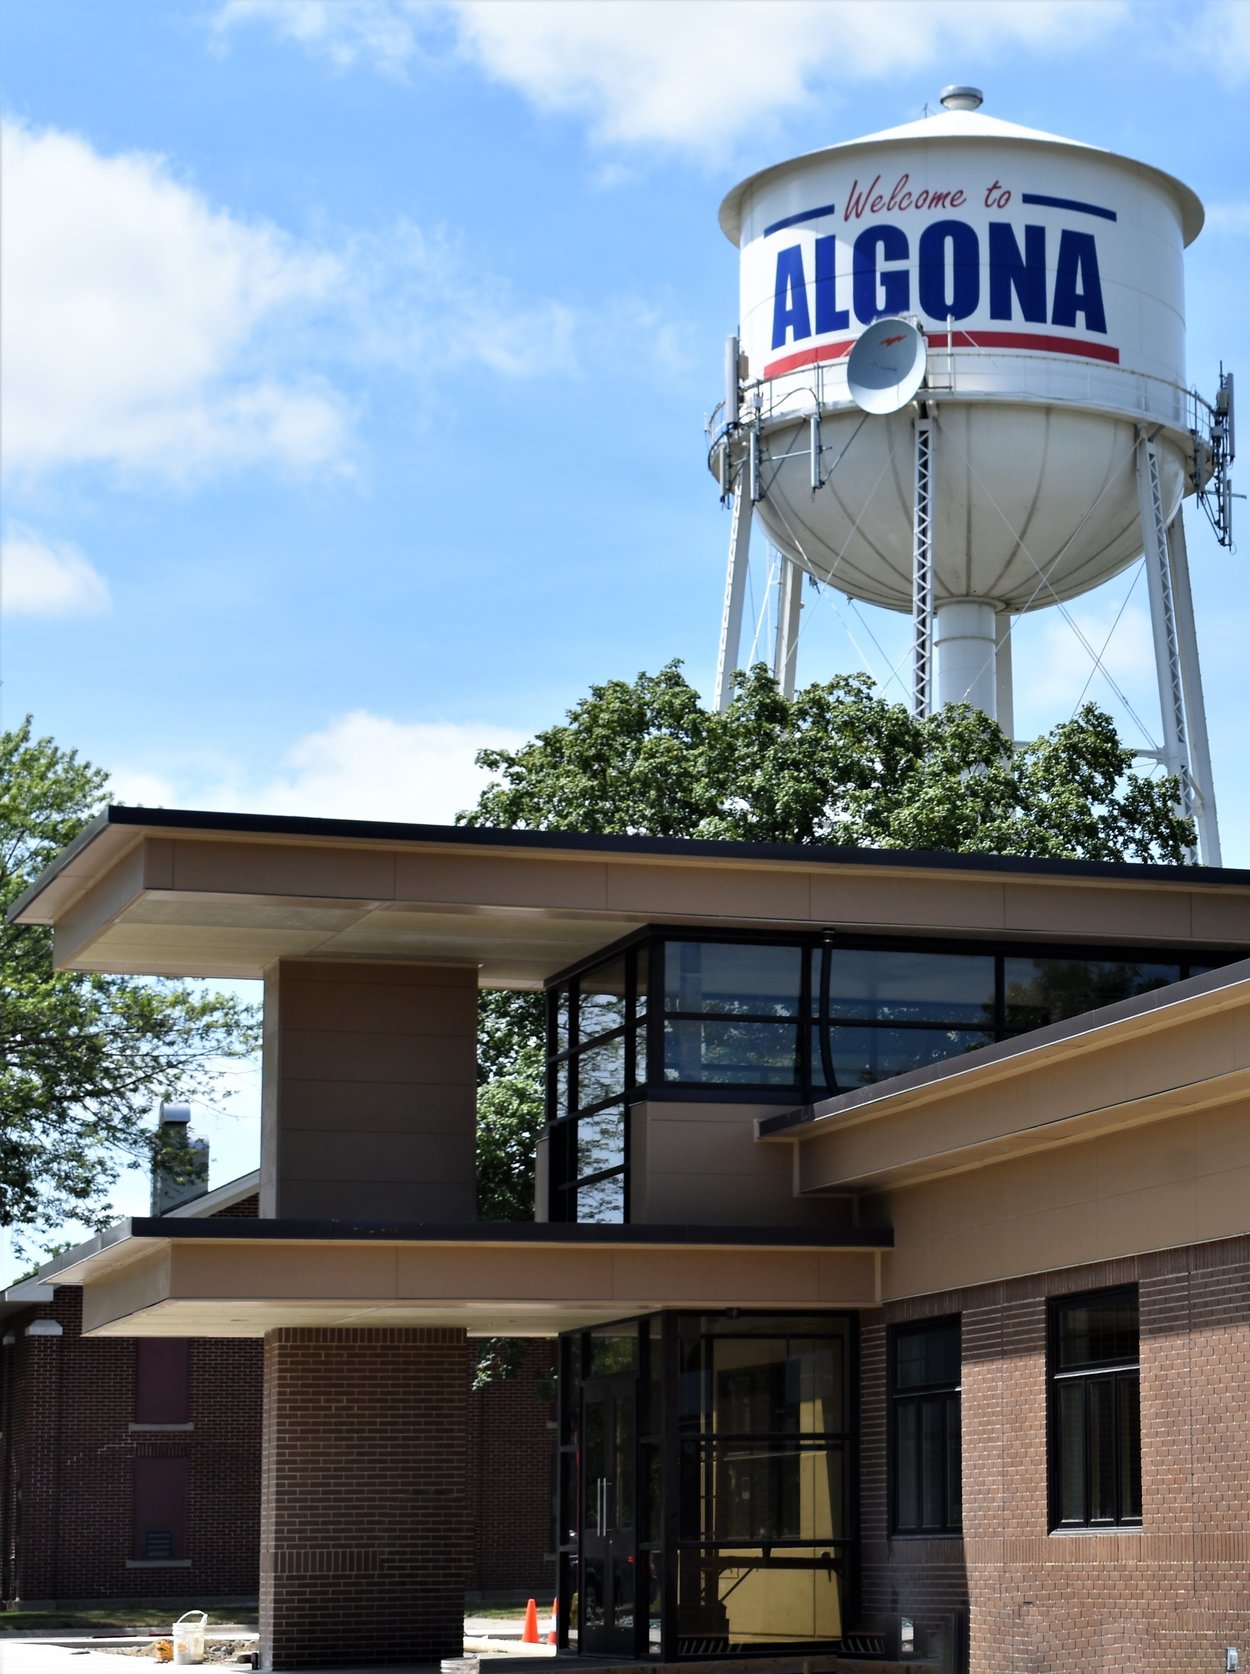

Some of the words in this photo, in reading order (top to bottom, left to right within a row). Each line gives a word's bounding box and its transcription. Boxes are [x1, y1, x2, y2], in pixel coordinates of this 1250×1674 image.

[844, 173, 966, 221] Welcome
[984, 180, 1011, 209] to
[771, 220, 1107, 350] ALGONA
